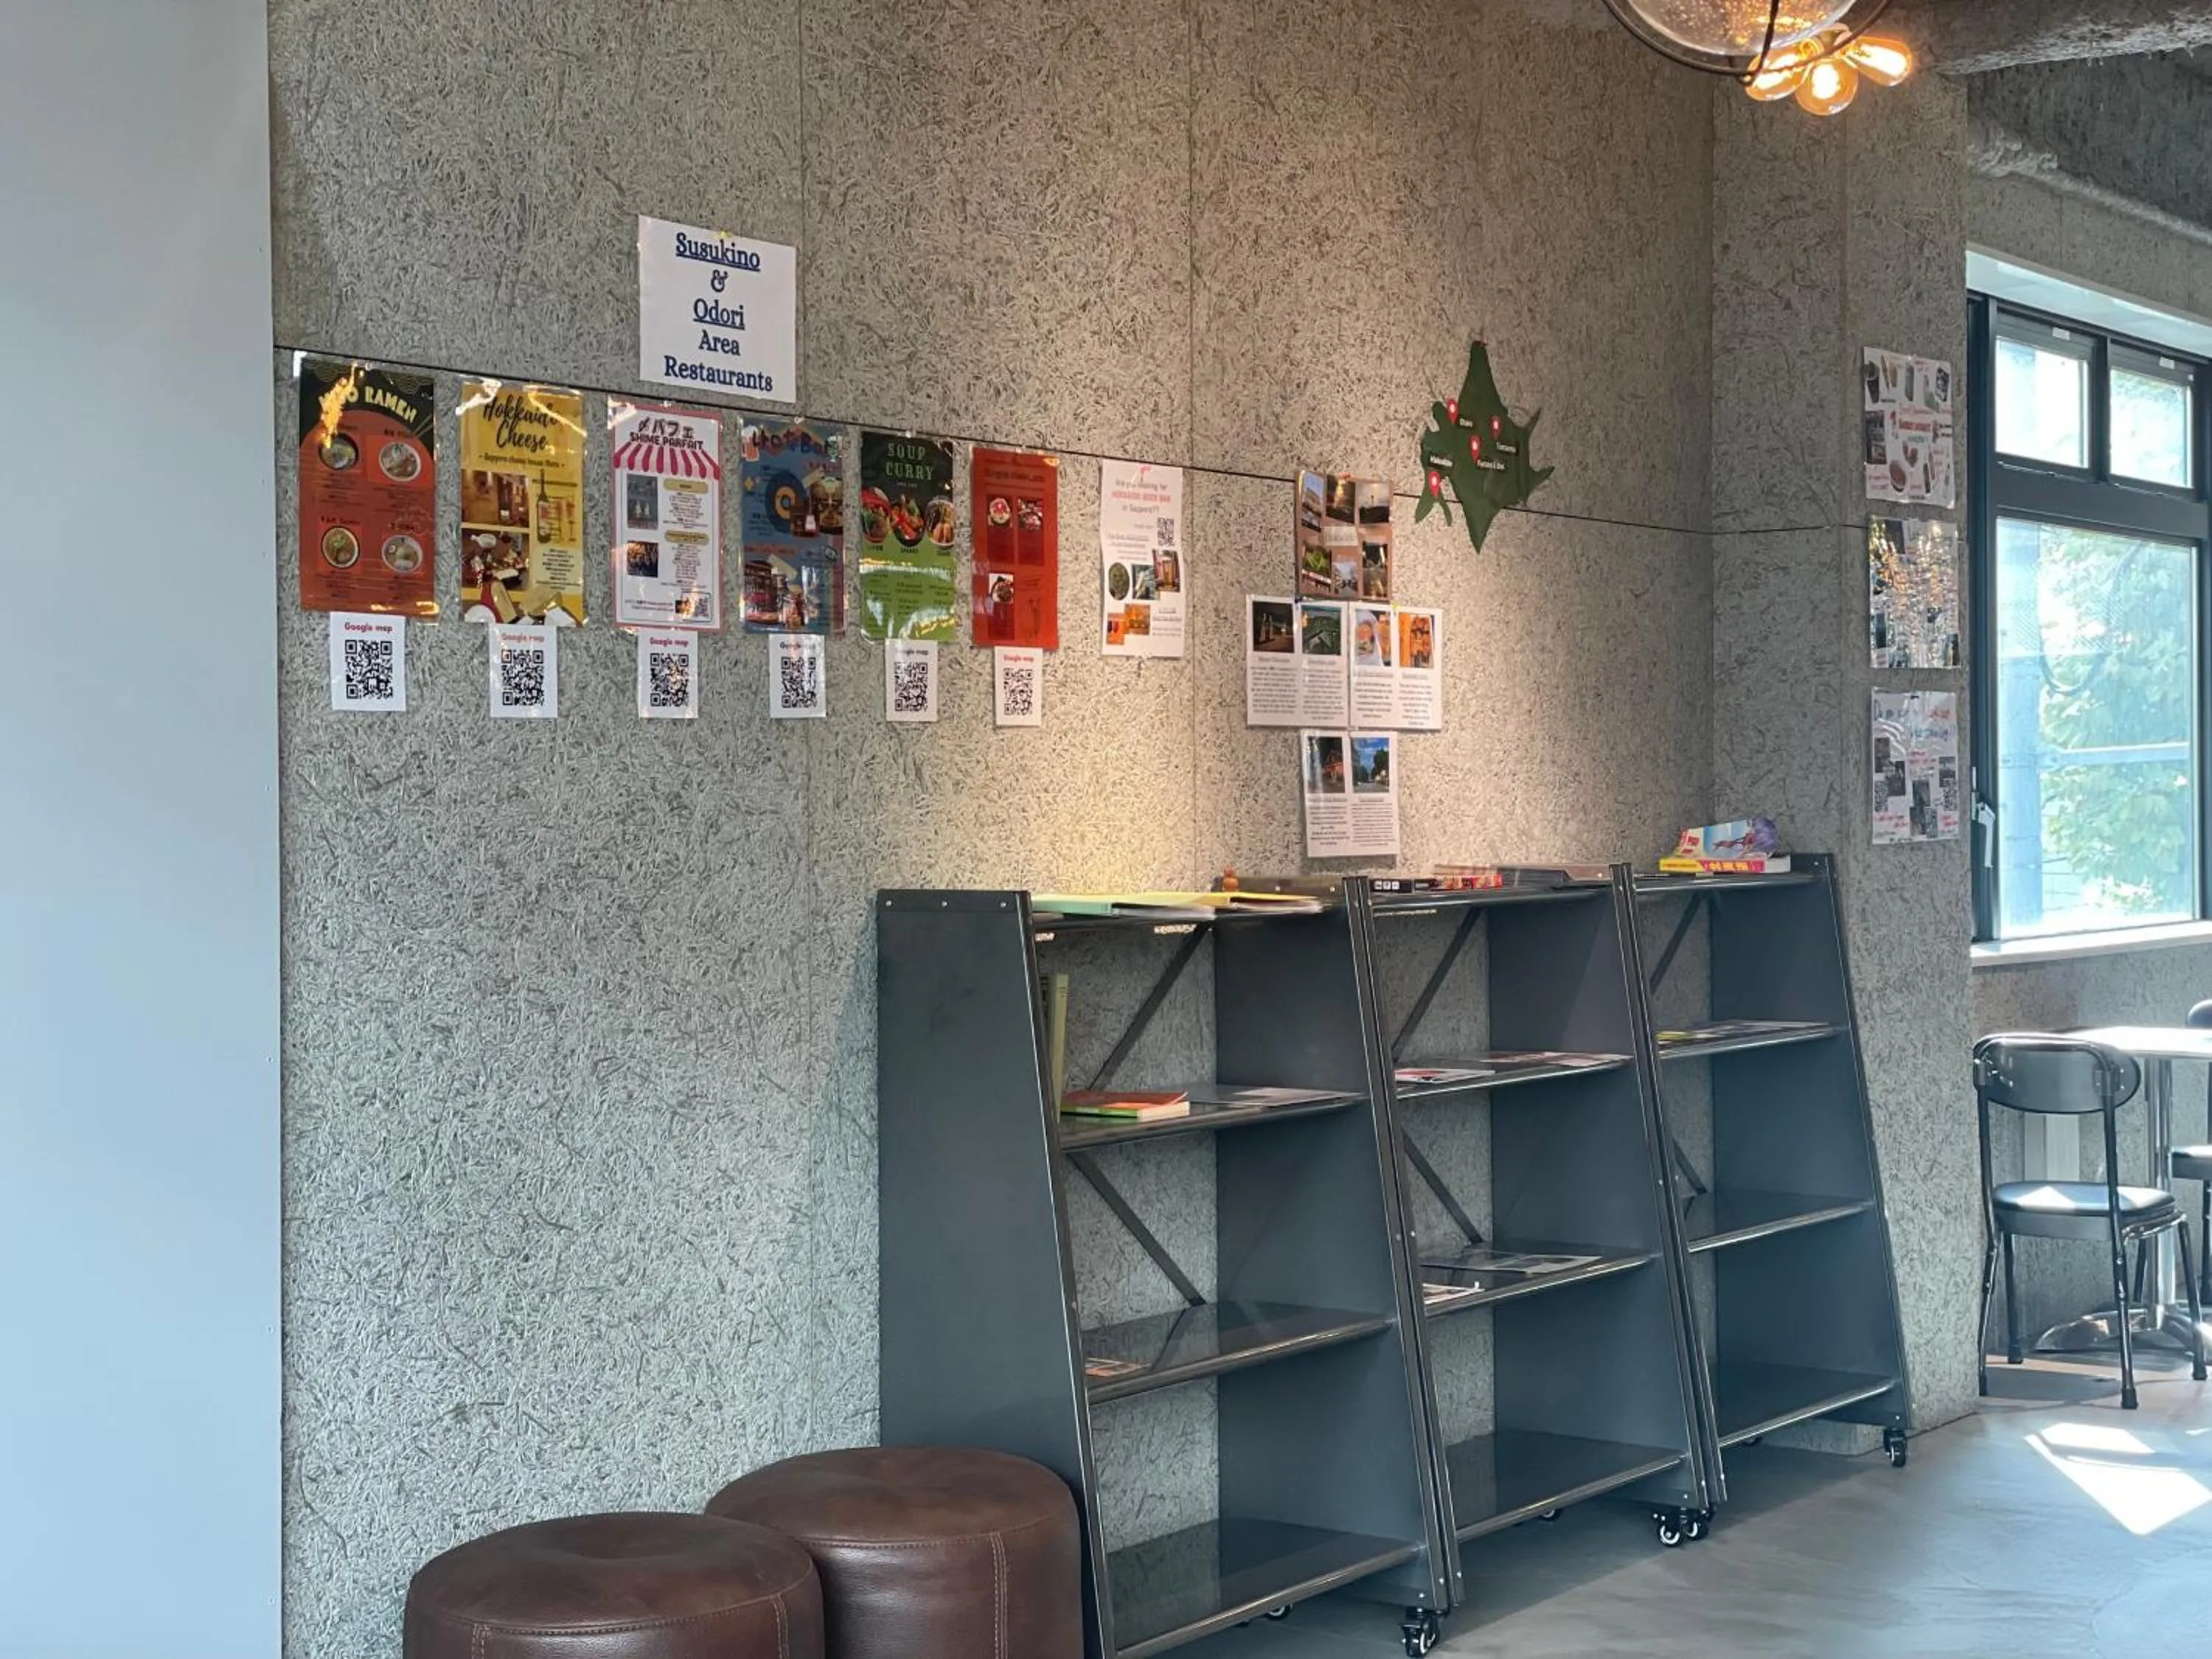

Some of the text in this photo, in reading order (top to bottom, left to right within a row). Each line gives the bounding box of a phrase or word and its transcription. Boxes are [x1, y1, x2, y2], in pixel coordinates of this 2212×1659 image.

[675, 232, 760, 271] Susukino
[711, 270, 728, 292] &
[693, 299, 745, 330] Odori
[699, 330, 740, 355] Area
[664, 355, 773, 391] Restaurants
[365, 386, 417, 423] RAMEN
[483, 394, 558, 428] Hokkaido
[496, 419, 548, 453] Cheese
[630, 432, 703, 450] SHIME PARFAIT
[887, 443, 925, 460] SOUP
[886, 461, 933, 481] CURRY
[344, 622, 392, 634] Google map
[501, 633, 528, 643] Google
[650, 636, 672, 647] Google
